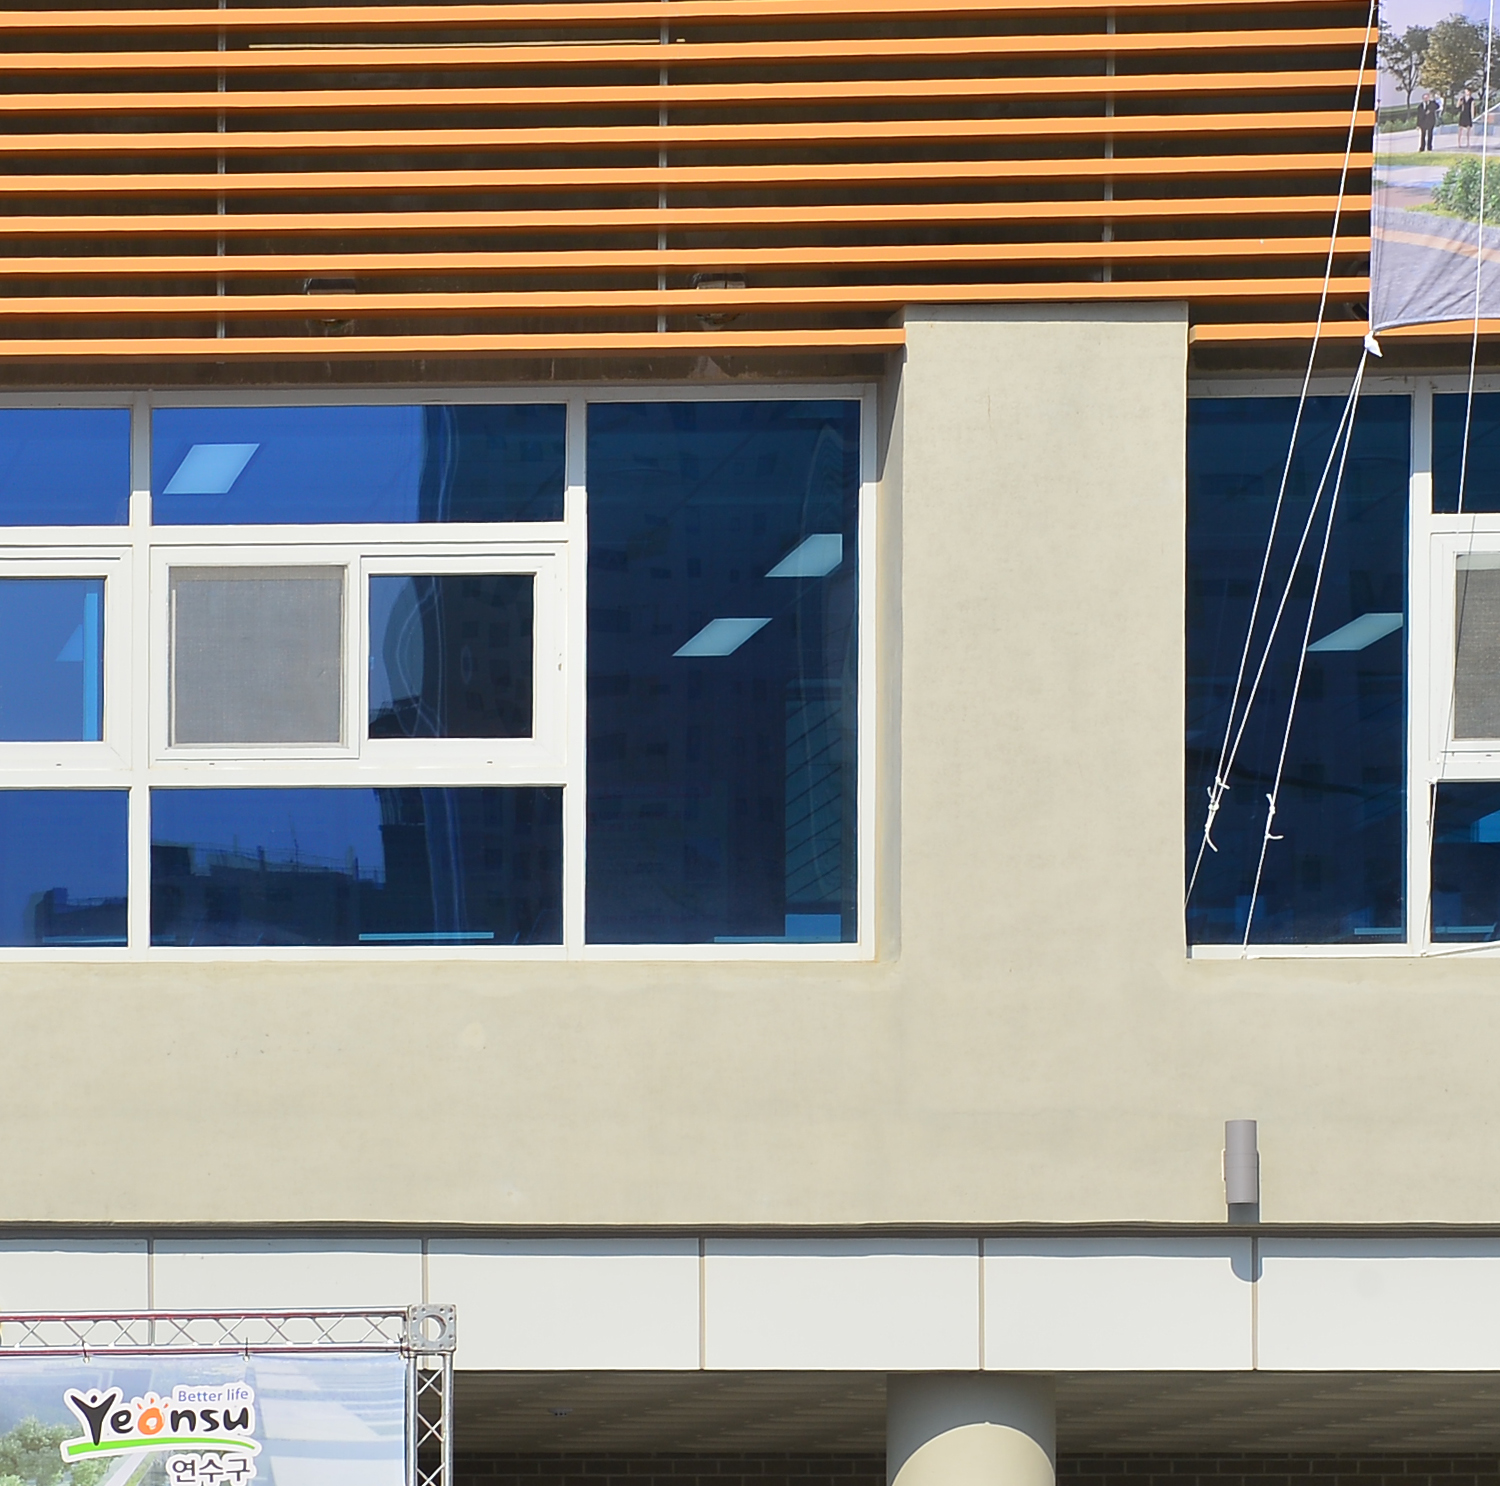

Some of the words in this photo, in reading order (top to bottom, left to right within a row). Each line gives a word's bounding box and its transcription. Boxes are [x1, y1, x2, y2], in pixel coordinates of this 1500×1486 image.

[179, 1389, 222, 1402] Better
[227, 1387, 249, 1401] life
[70, 1393, 249, 1446] Yeonsu
[173, 1459, 250, 1482] 연수구
